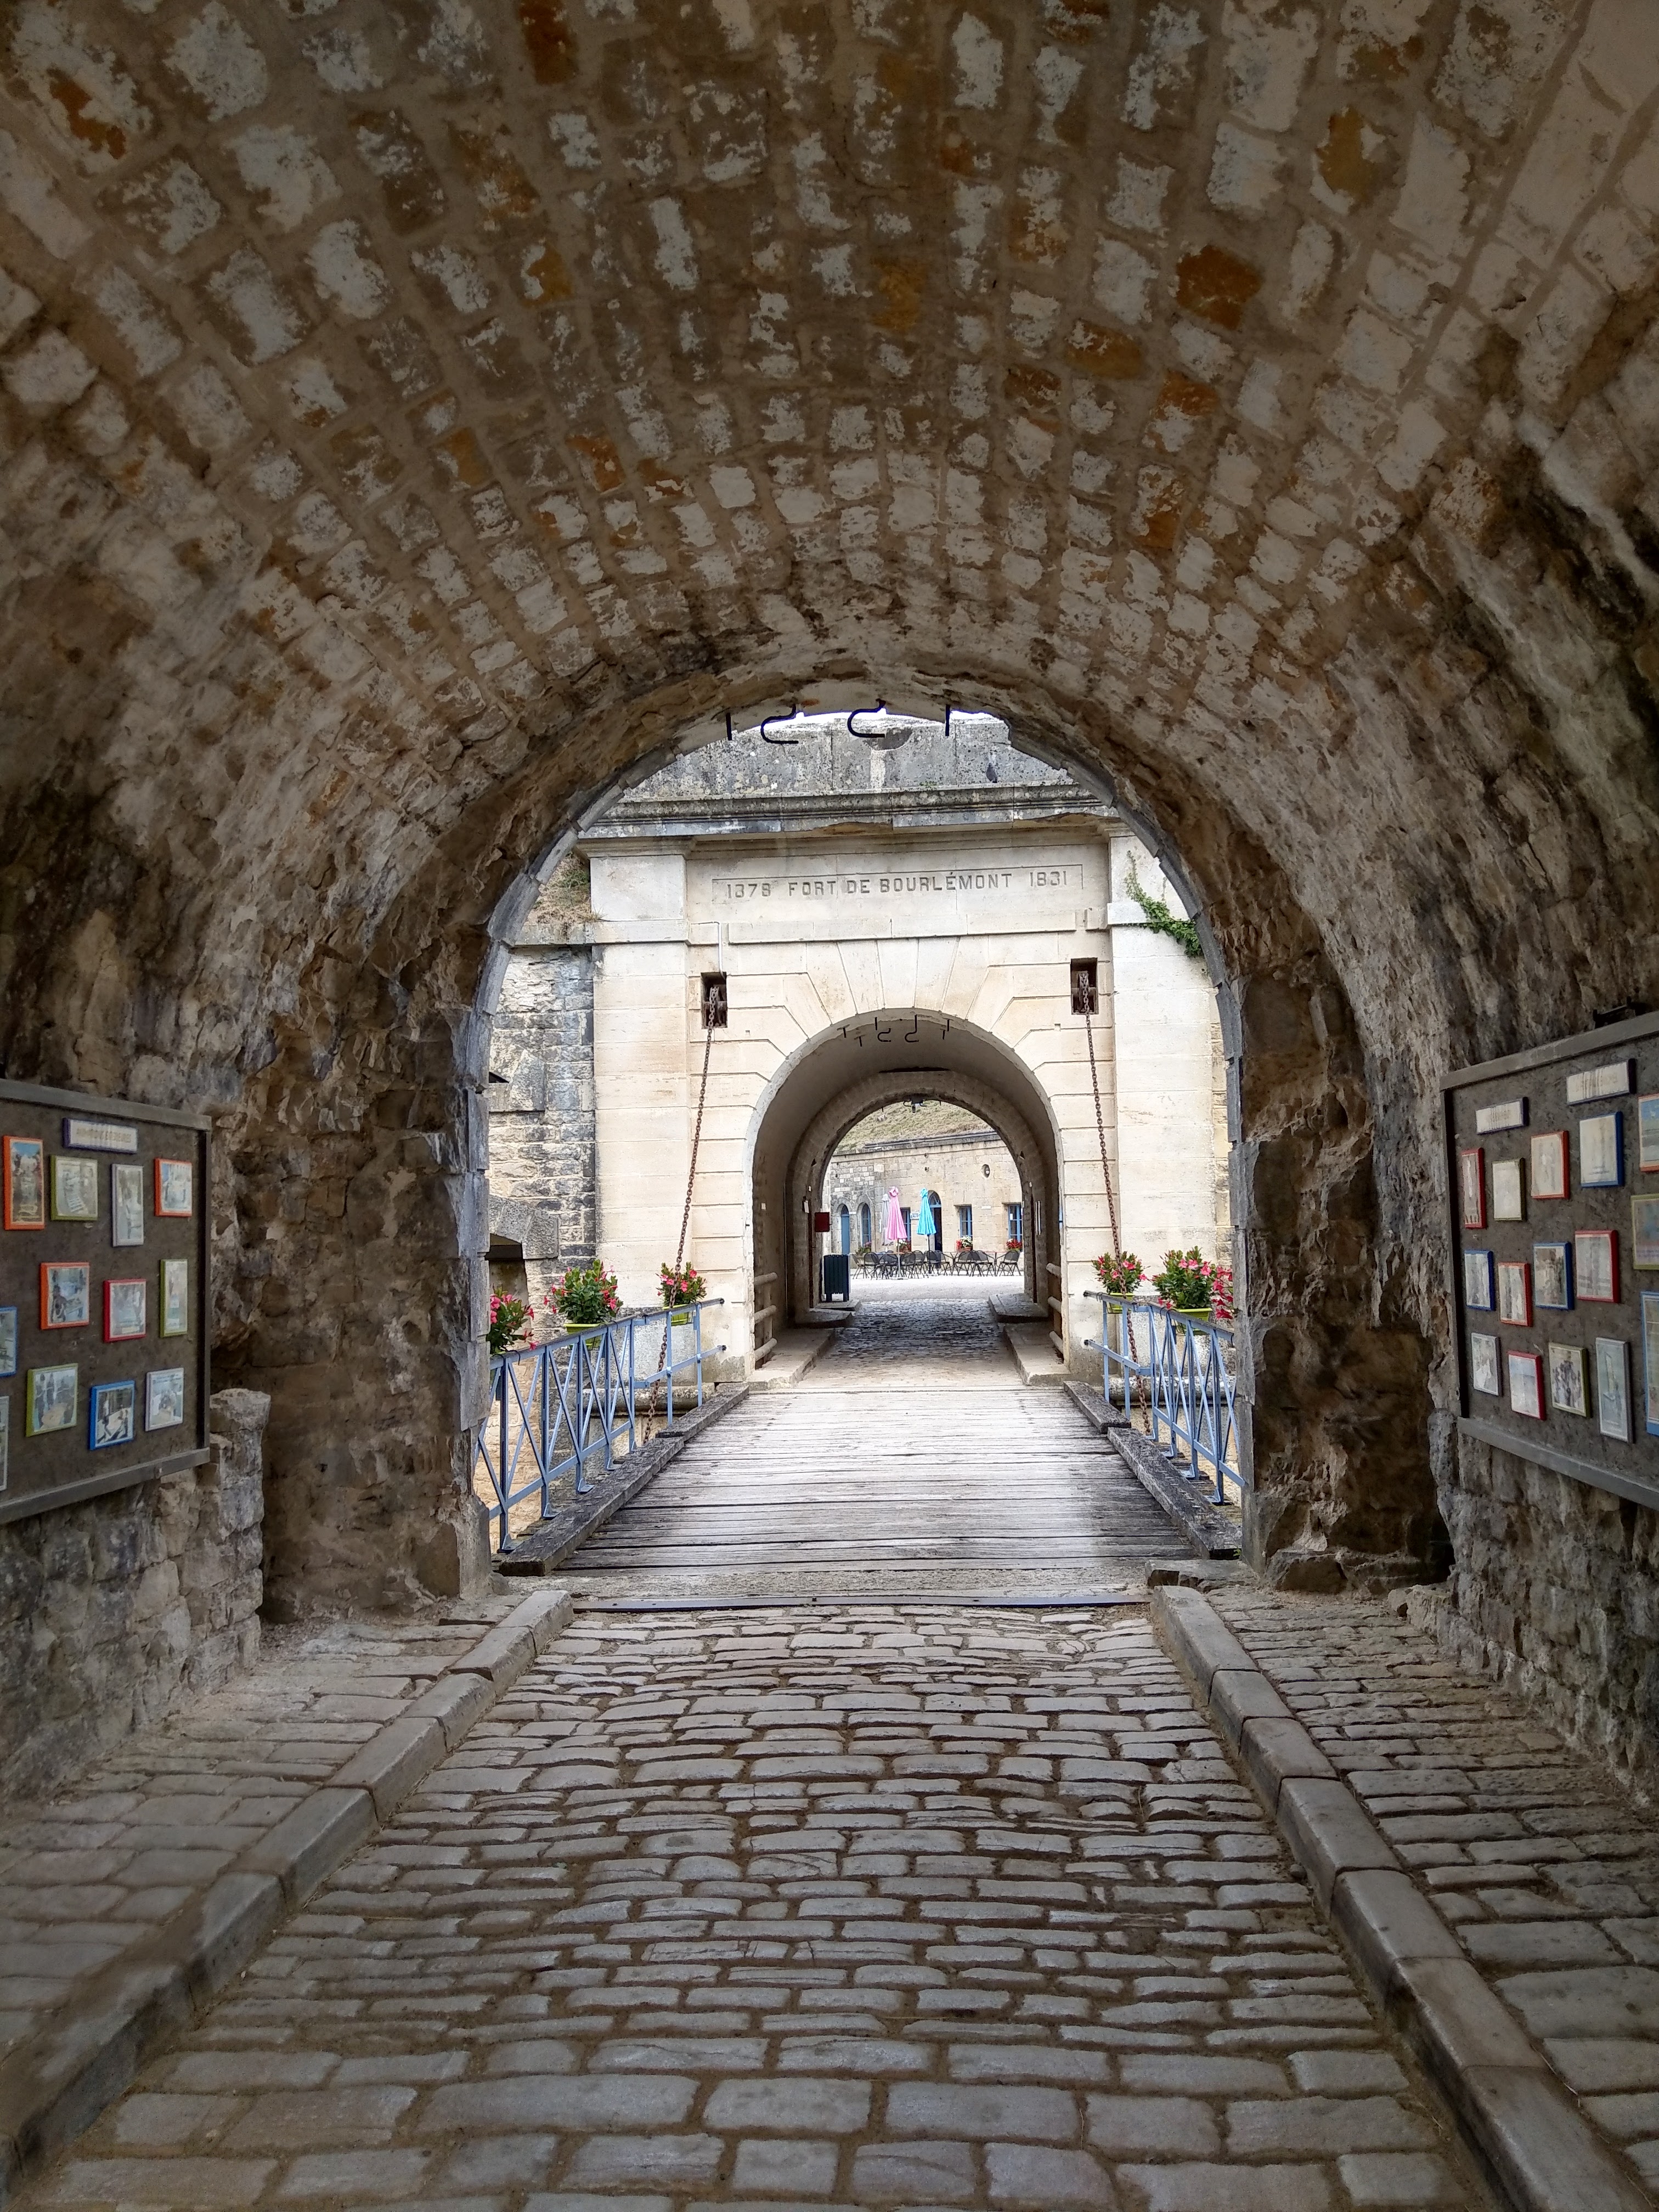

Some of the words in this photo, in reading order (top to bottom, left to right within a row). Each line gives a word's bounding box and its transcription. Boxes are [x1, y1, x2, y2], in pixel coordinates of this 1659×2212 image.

[788, 881, 836, 896] FORT
[846, 879, 870, 894] DE
[879, 871, 1012, 893] BOURLÉMONT
